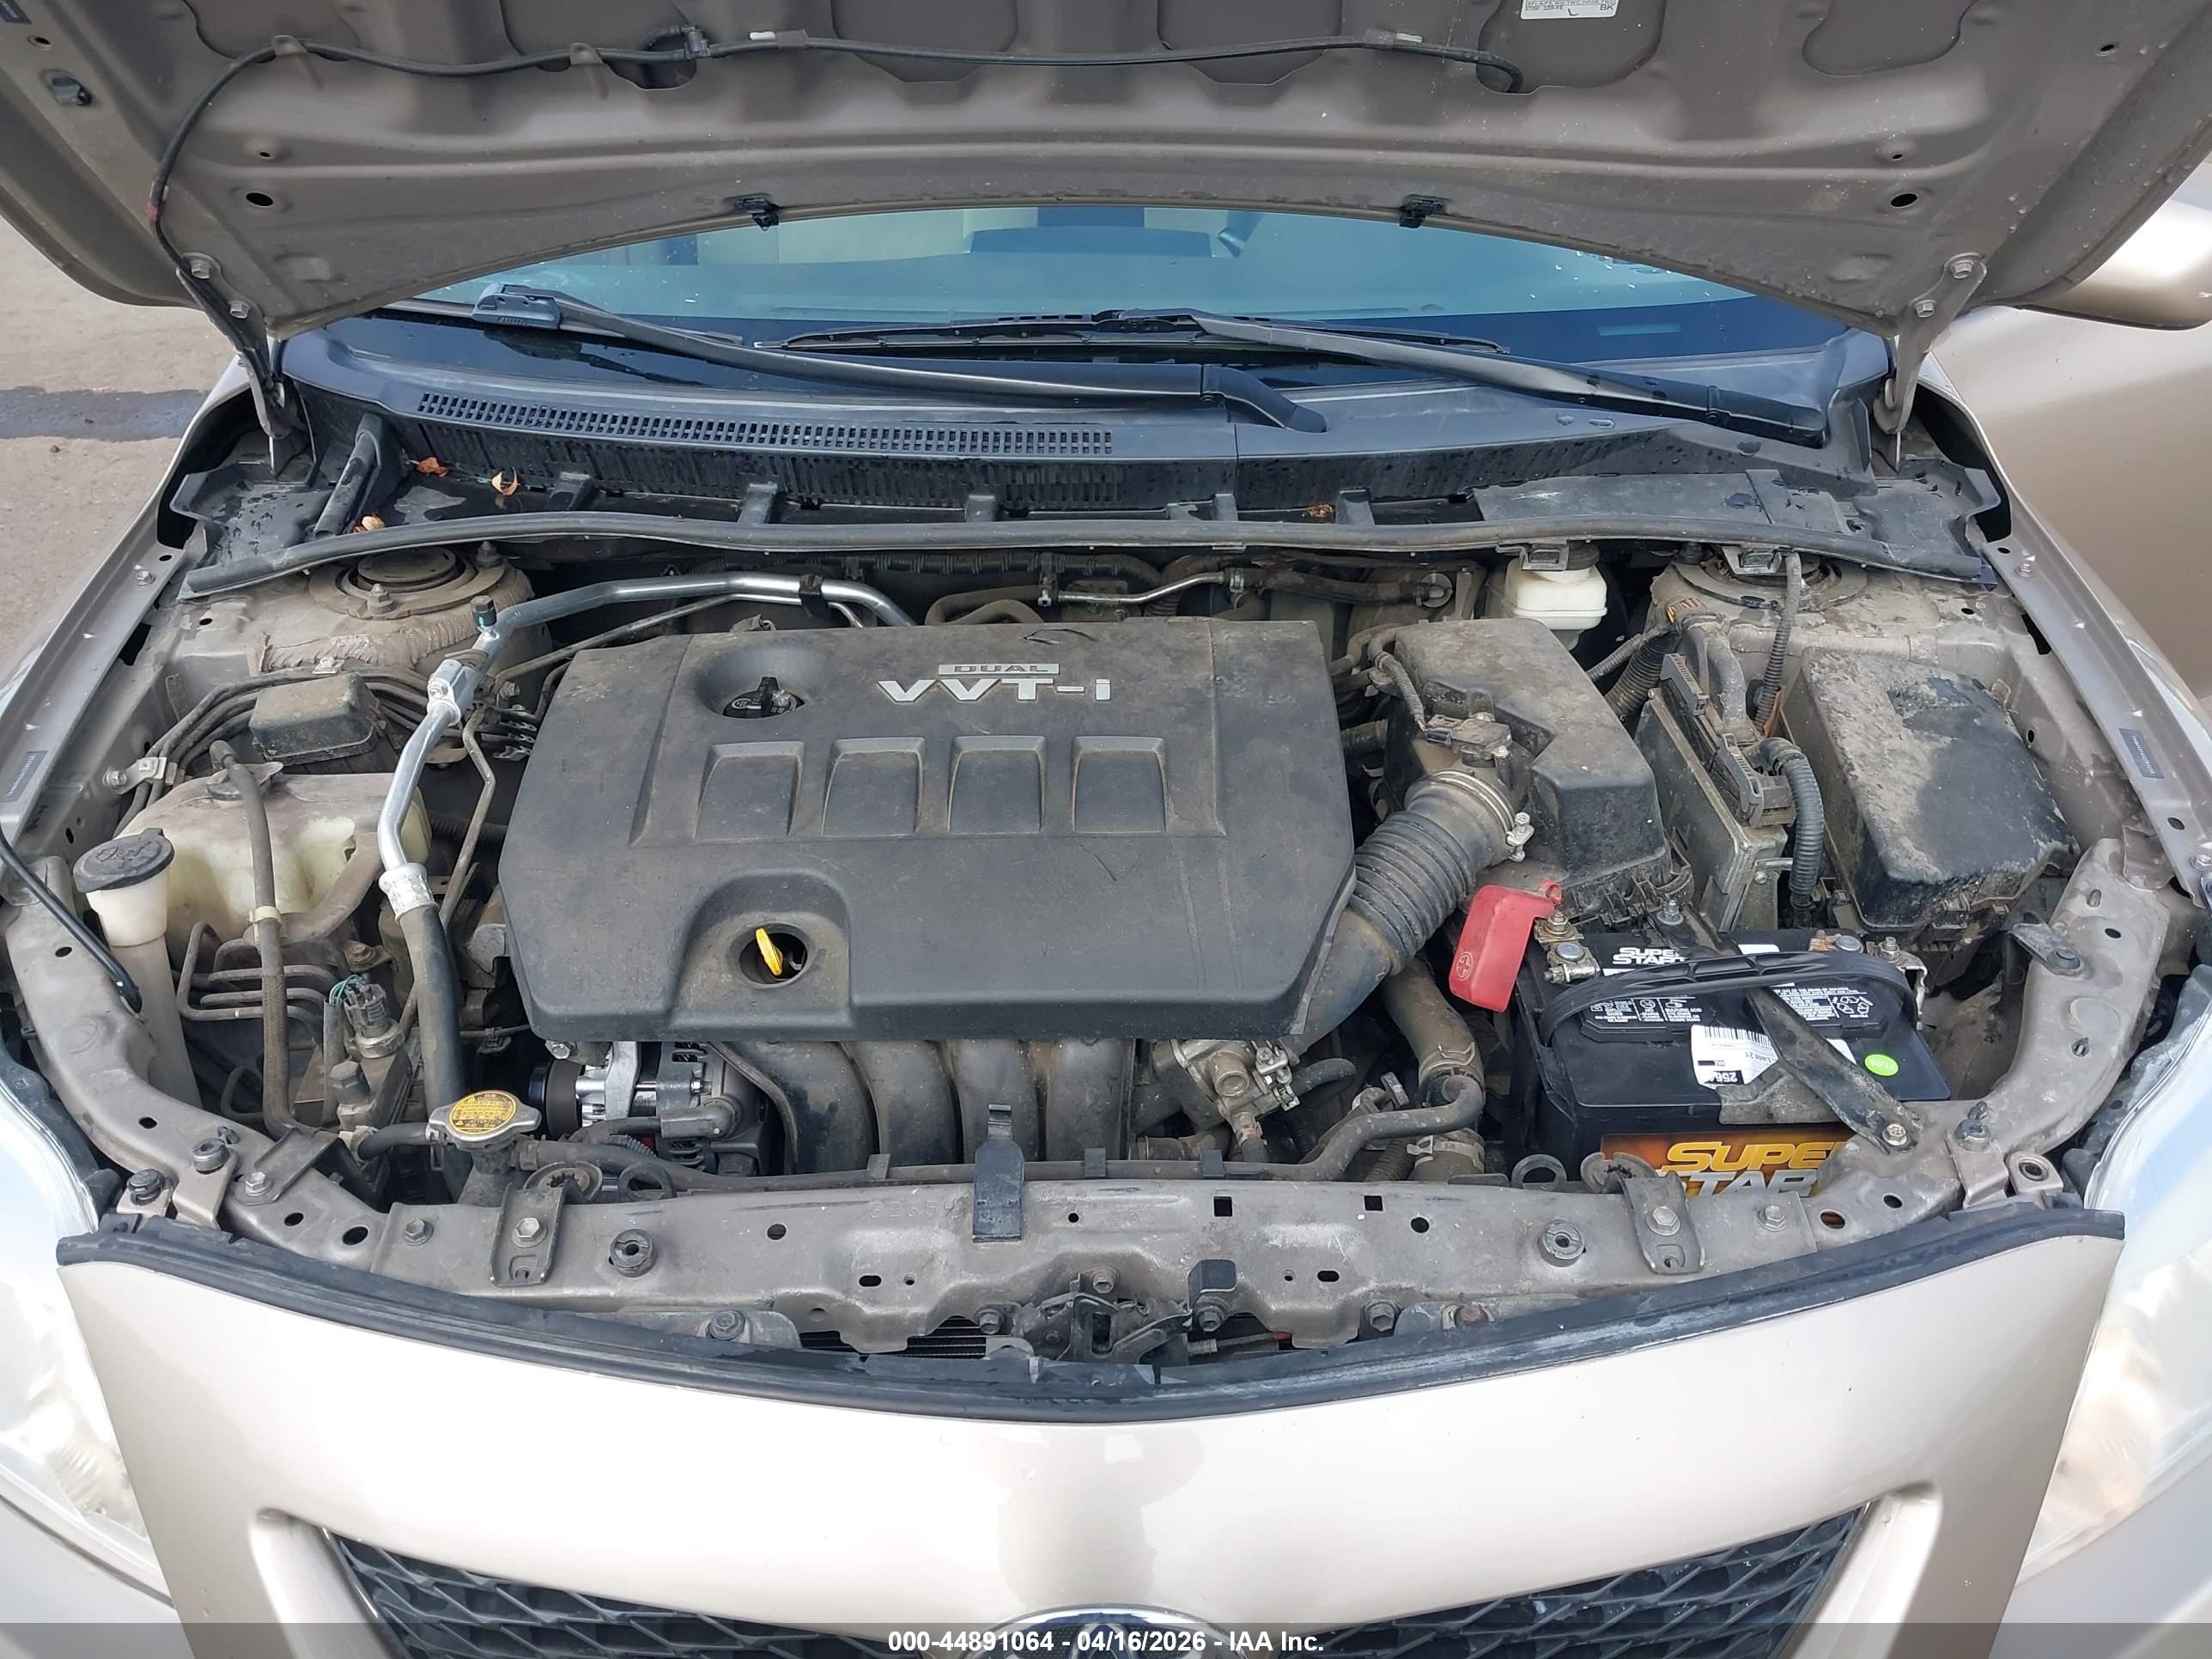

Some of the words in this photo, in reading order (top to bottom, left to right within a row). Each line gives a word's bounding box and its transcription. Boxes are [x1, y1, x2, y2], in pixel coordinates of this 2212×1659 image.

[954, 665, 1049, 673] DUAL
[877, 678, 1112, 702] VVT-i
[1620, 947, 1680, 957] SUPE
[1661, 1141, 1847, 1172] SUPE
[1655, 1169, 1818, 1197] TAR
